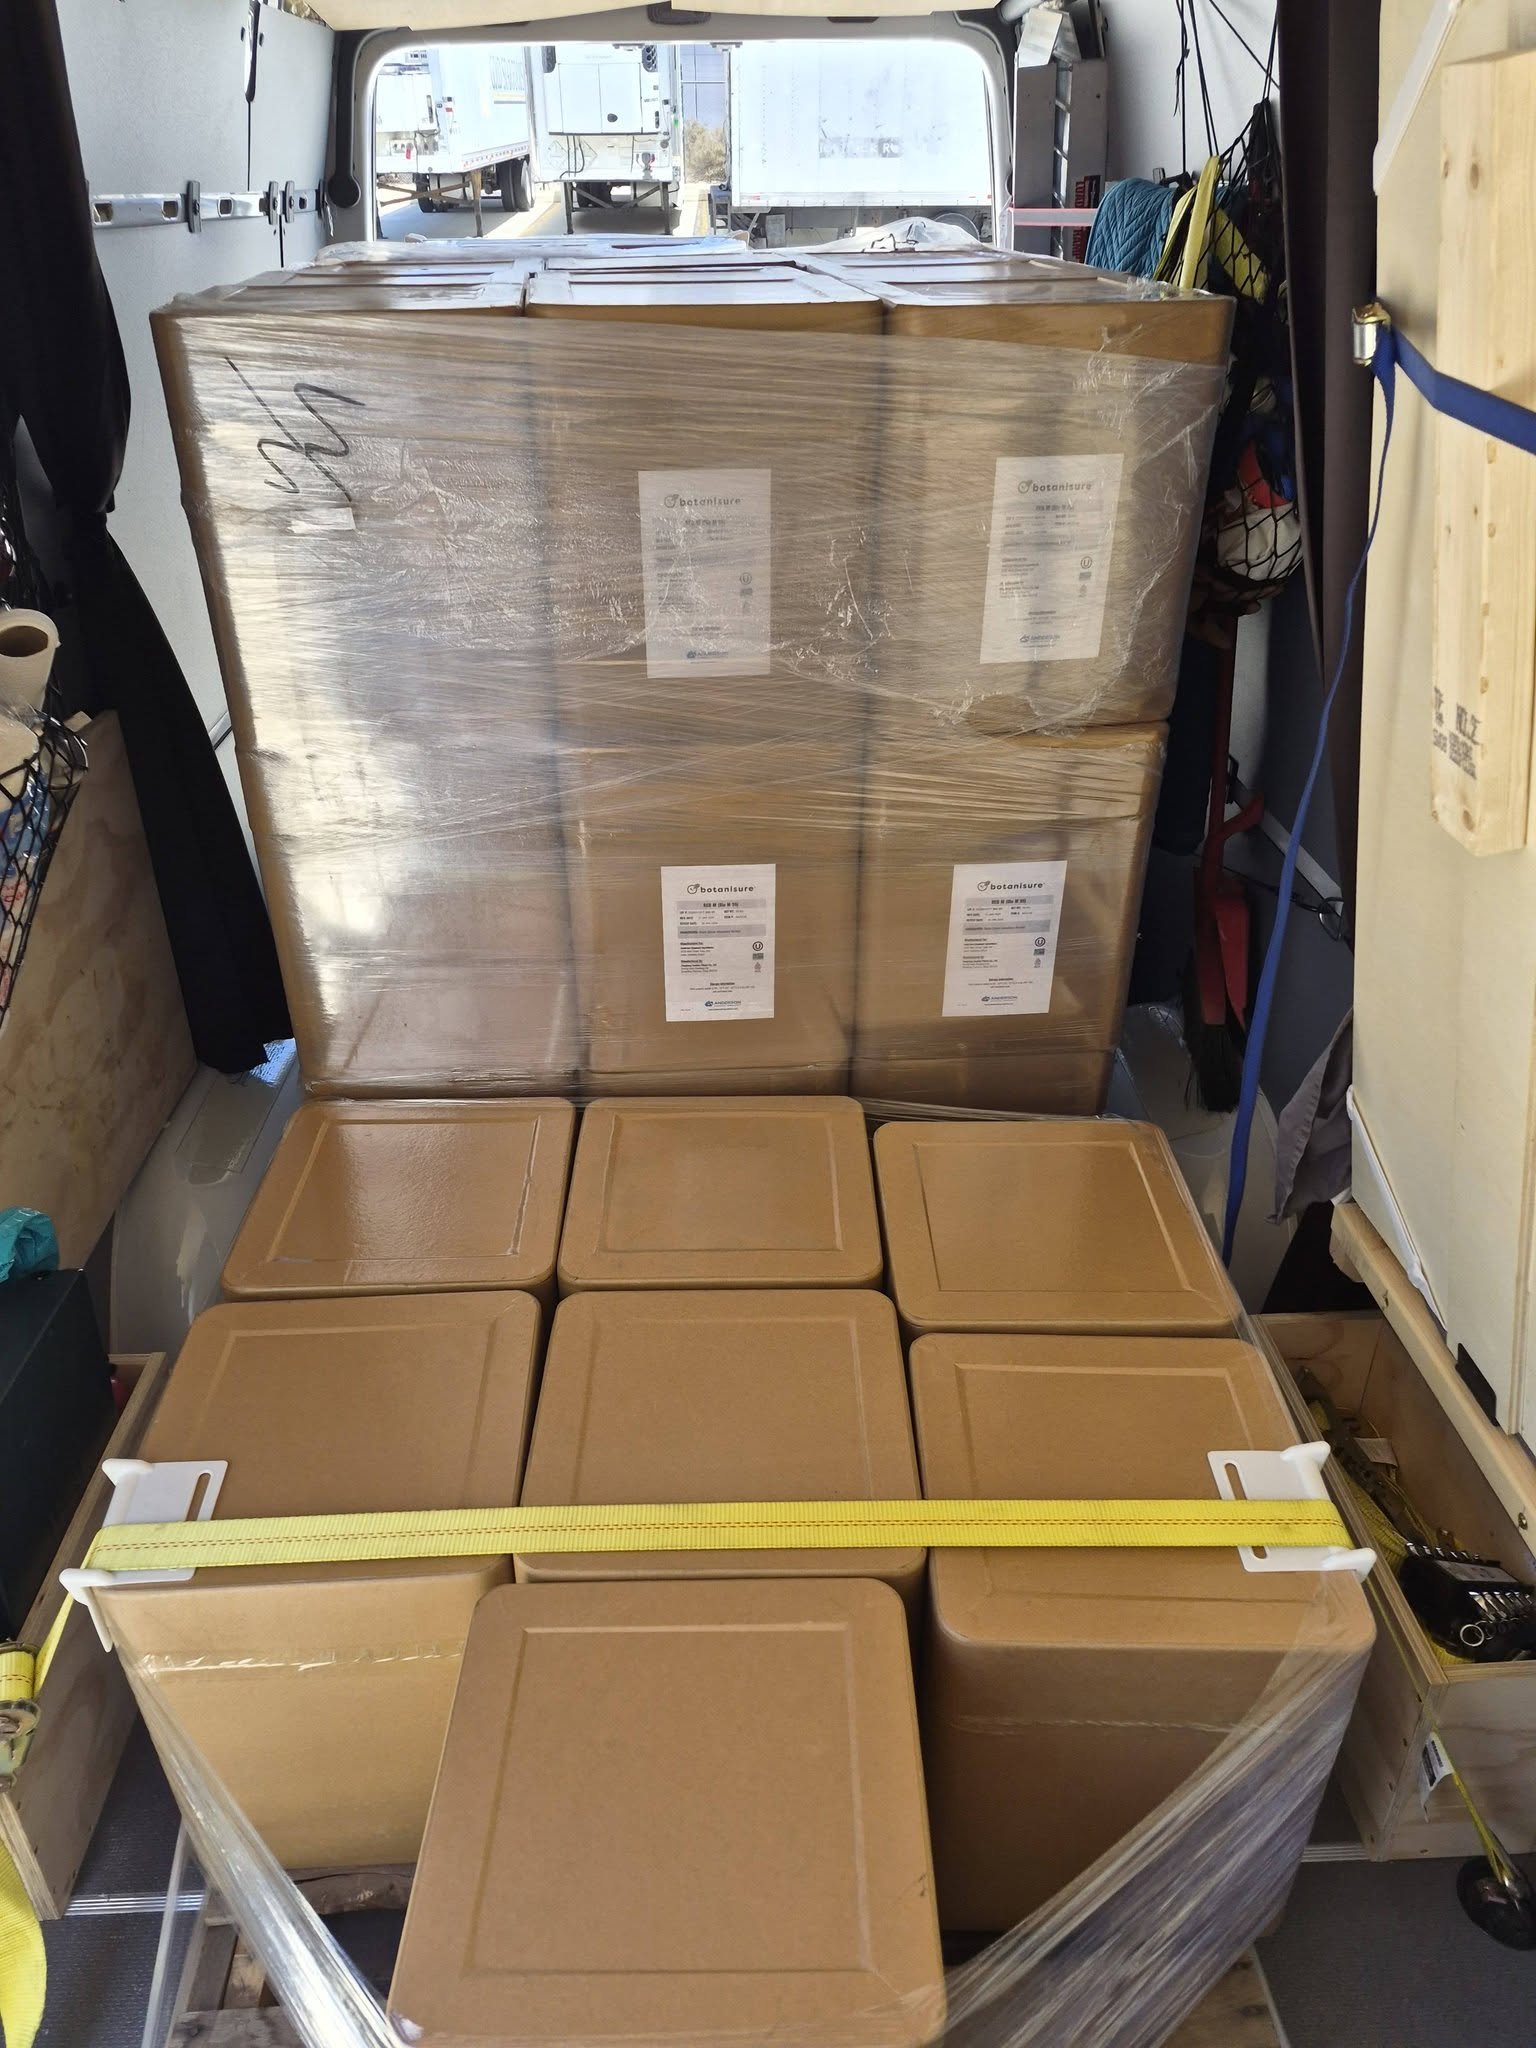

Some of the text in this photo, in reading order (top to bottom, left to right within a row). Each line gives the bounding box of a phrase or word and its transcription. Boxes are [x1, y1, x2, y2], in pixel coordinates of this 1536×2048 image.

[1032, 482, 1092, 493] botanisure
[679, 496, 741, 507] botanisure
[700, 885, 754, 894] botanisure
[990, 882, 1044, 891] botanisure
